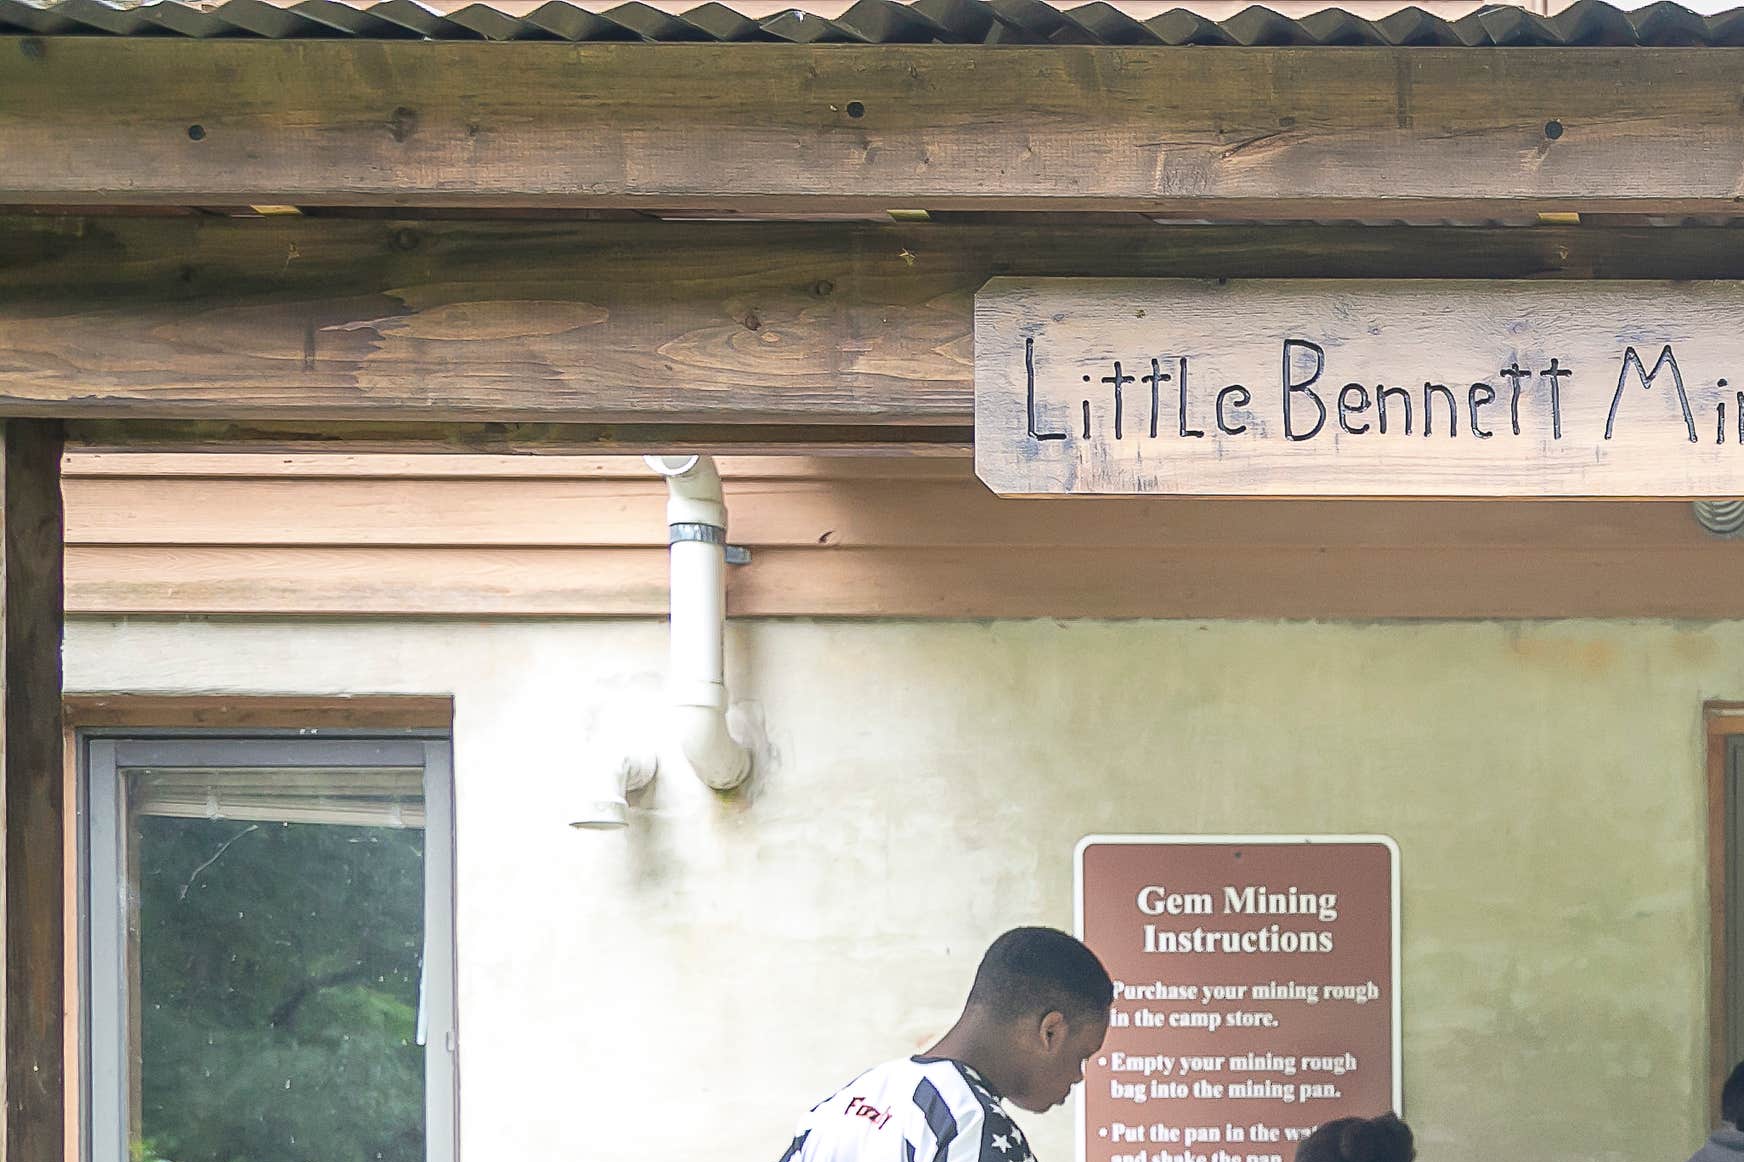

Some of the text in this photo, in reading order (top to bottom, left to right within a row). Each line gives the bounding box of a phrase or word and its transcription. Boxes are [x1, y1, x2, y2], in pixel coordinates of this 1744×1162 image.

[1282, 338, 1573, 442] Bennett
[1137, 886, 1338, 922] Gem Mining
[1143, 924, 1333, 953] Instructions
[1112, 980, 1379, 1005] Purchase your mining rough
[1109, 1007, 1279, 1032] in the camp store.
[1110, 1051, 1357, 1077] Empty your mining rough
[1110, 1078, 1341, 1104] bag into the mining pan.
[1111, 1122, 1146, 1143] Put
[1149, 1122, 1181, 1143] the
[1183, 1126, 1221, 1148] pan
[1225, 1123, 1245, 1142] in
[1249, 1123, 1280, 1142] the
